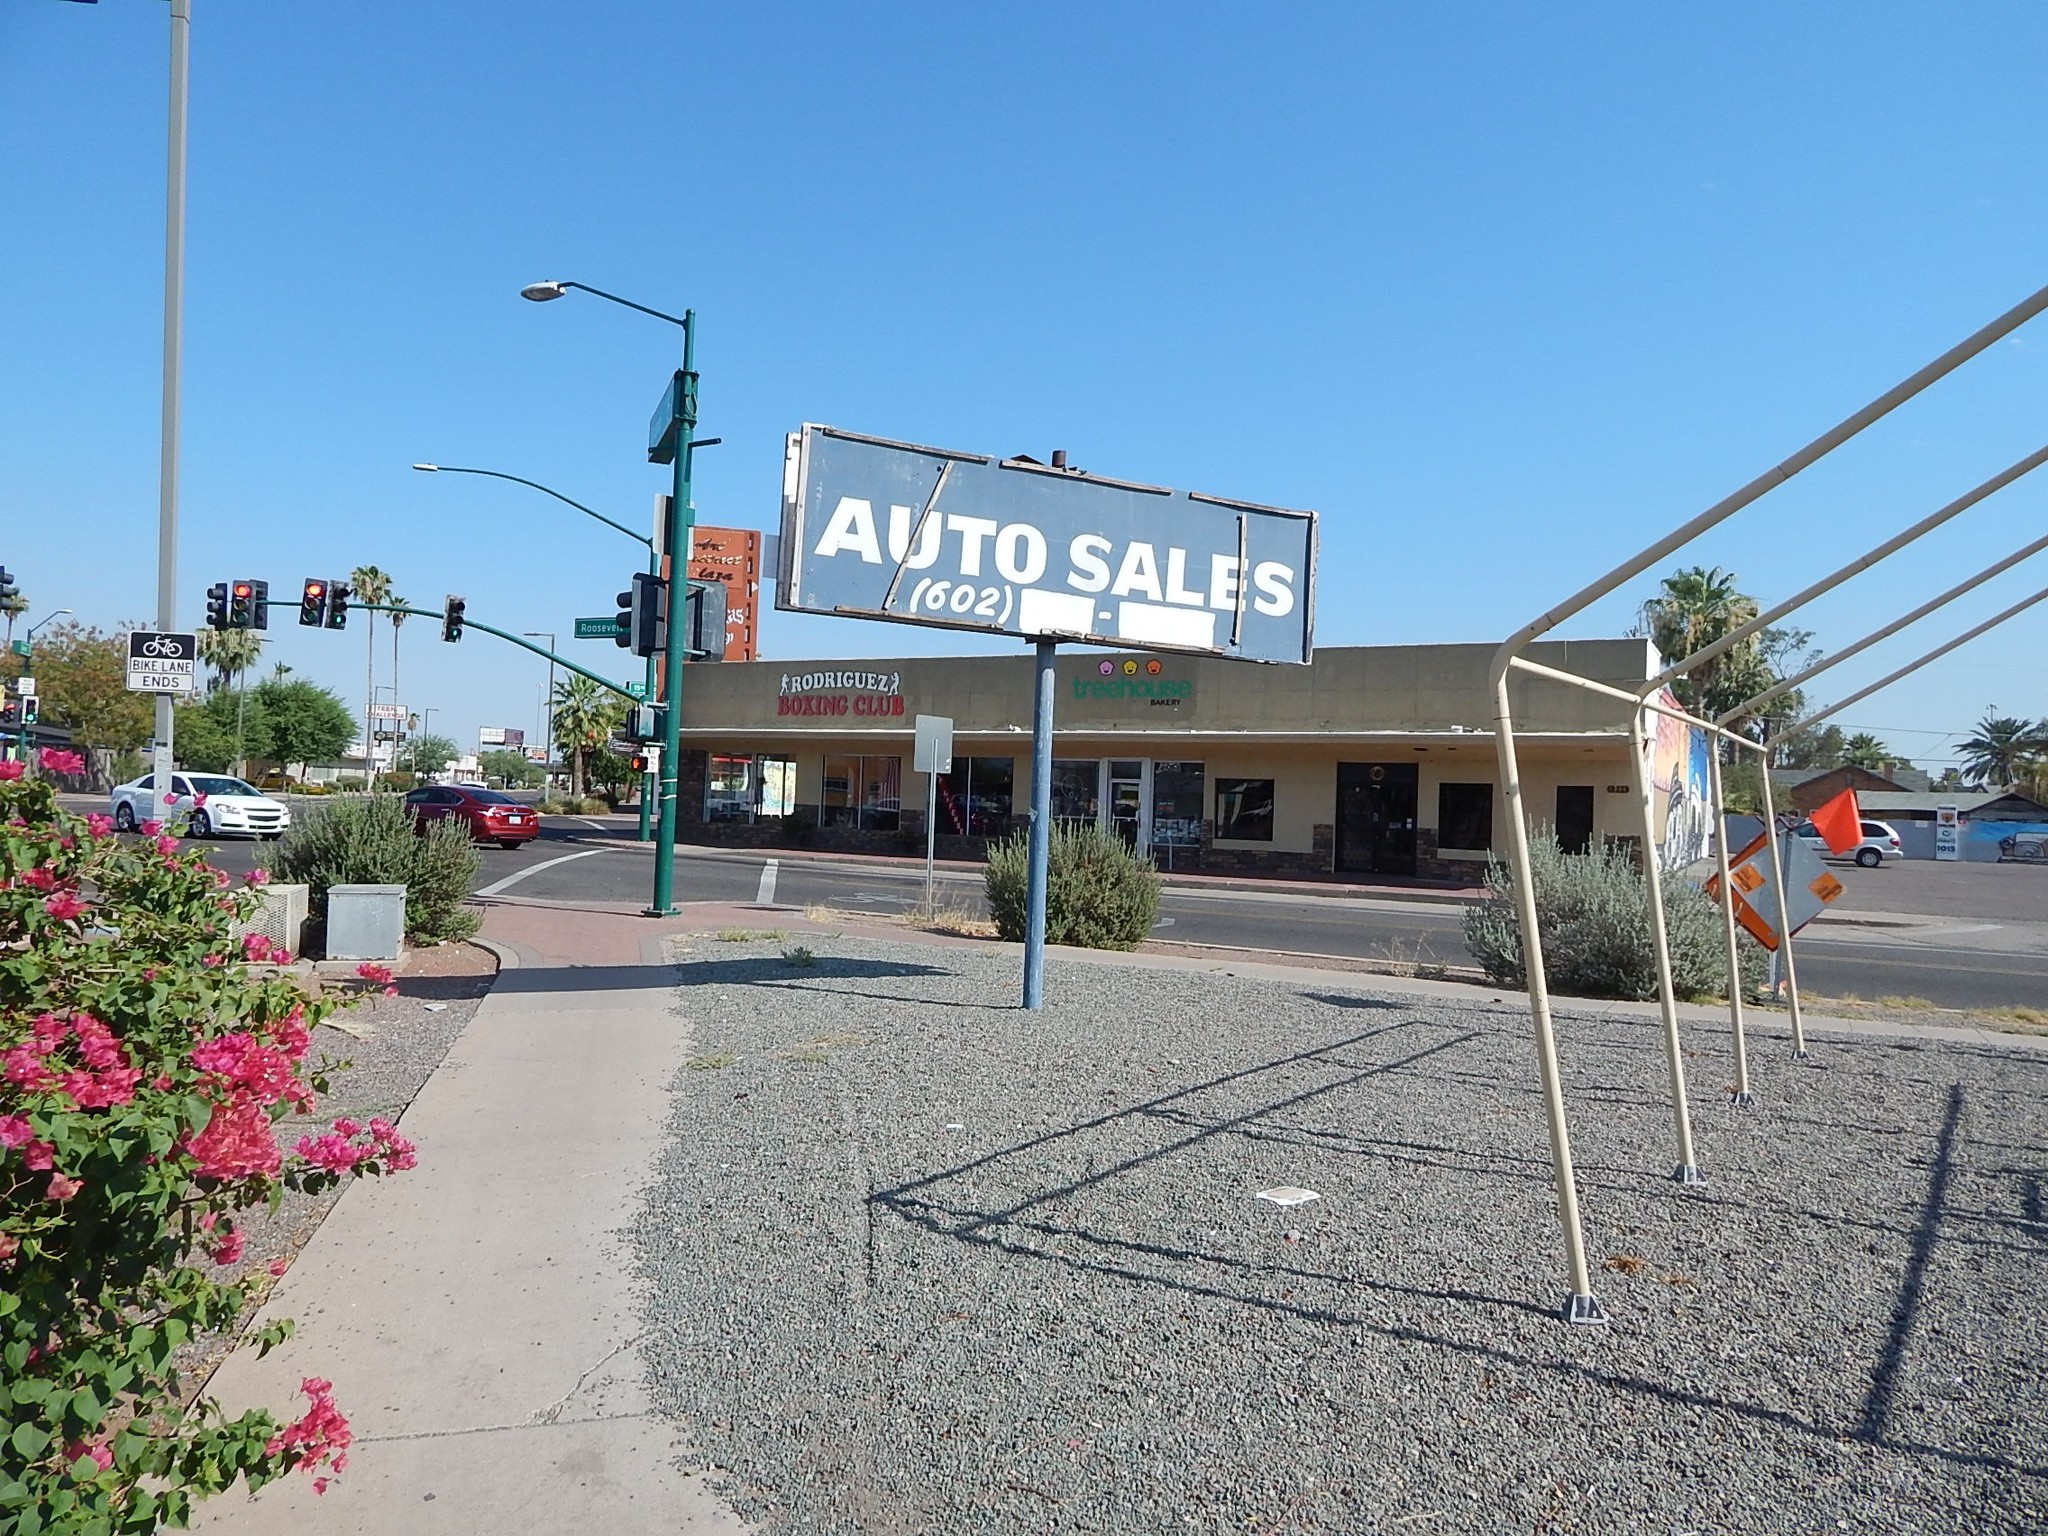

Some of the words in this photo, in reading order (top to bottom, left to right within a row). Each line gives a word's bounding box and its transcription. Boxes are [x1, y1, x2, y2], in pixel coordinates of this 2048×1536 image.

[814, 496, 1048, 585] AUTO
[1066, 532, 1295, 617] SALES
[909, 577, 1014, 625] (602)
[133, 659, 158, 671] BIKE
[162, 661, 191, 673] LANE
[142, 675, 179, 688] ENDS
[791, 671, 889, 692] RODRIGUEZ
[1072, 676, 1193, 699] treehouse
[777, 695, 848, 716] BOXING
[852, 695, 905, 716] CLUB
